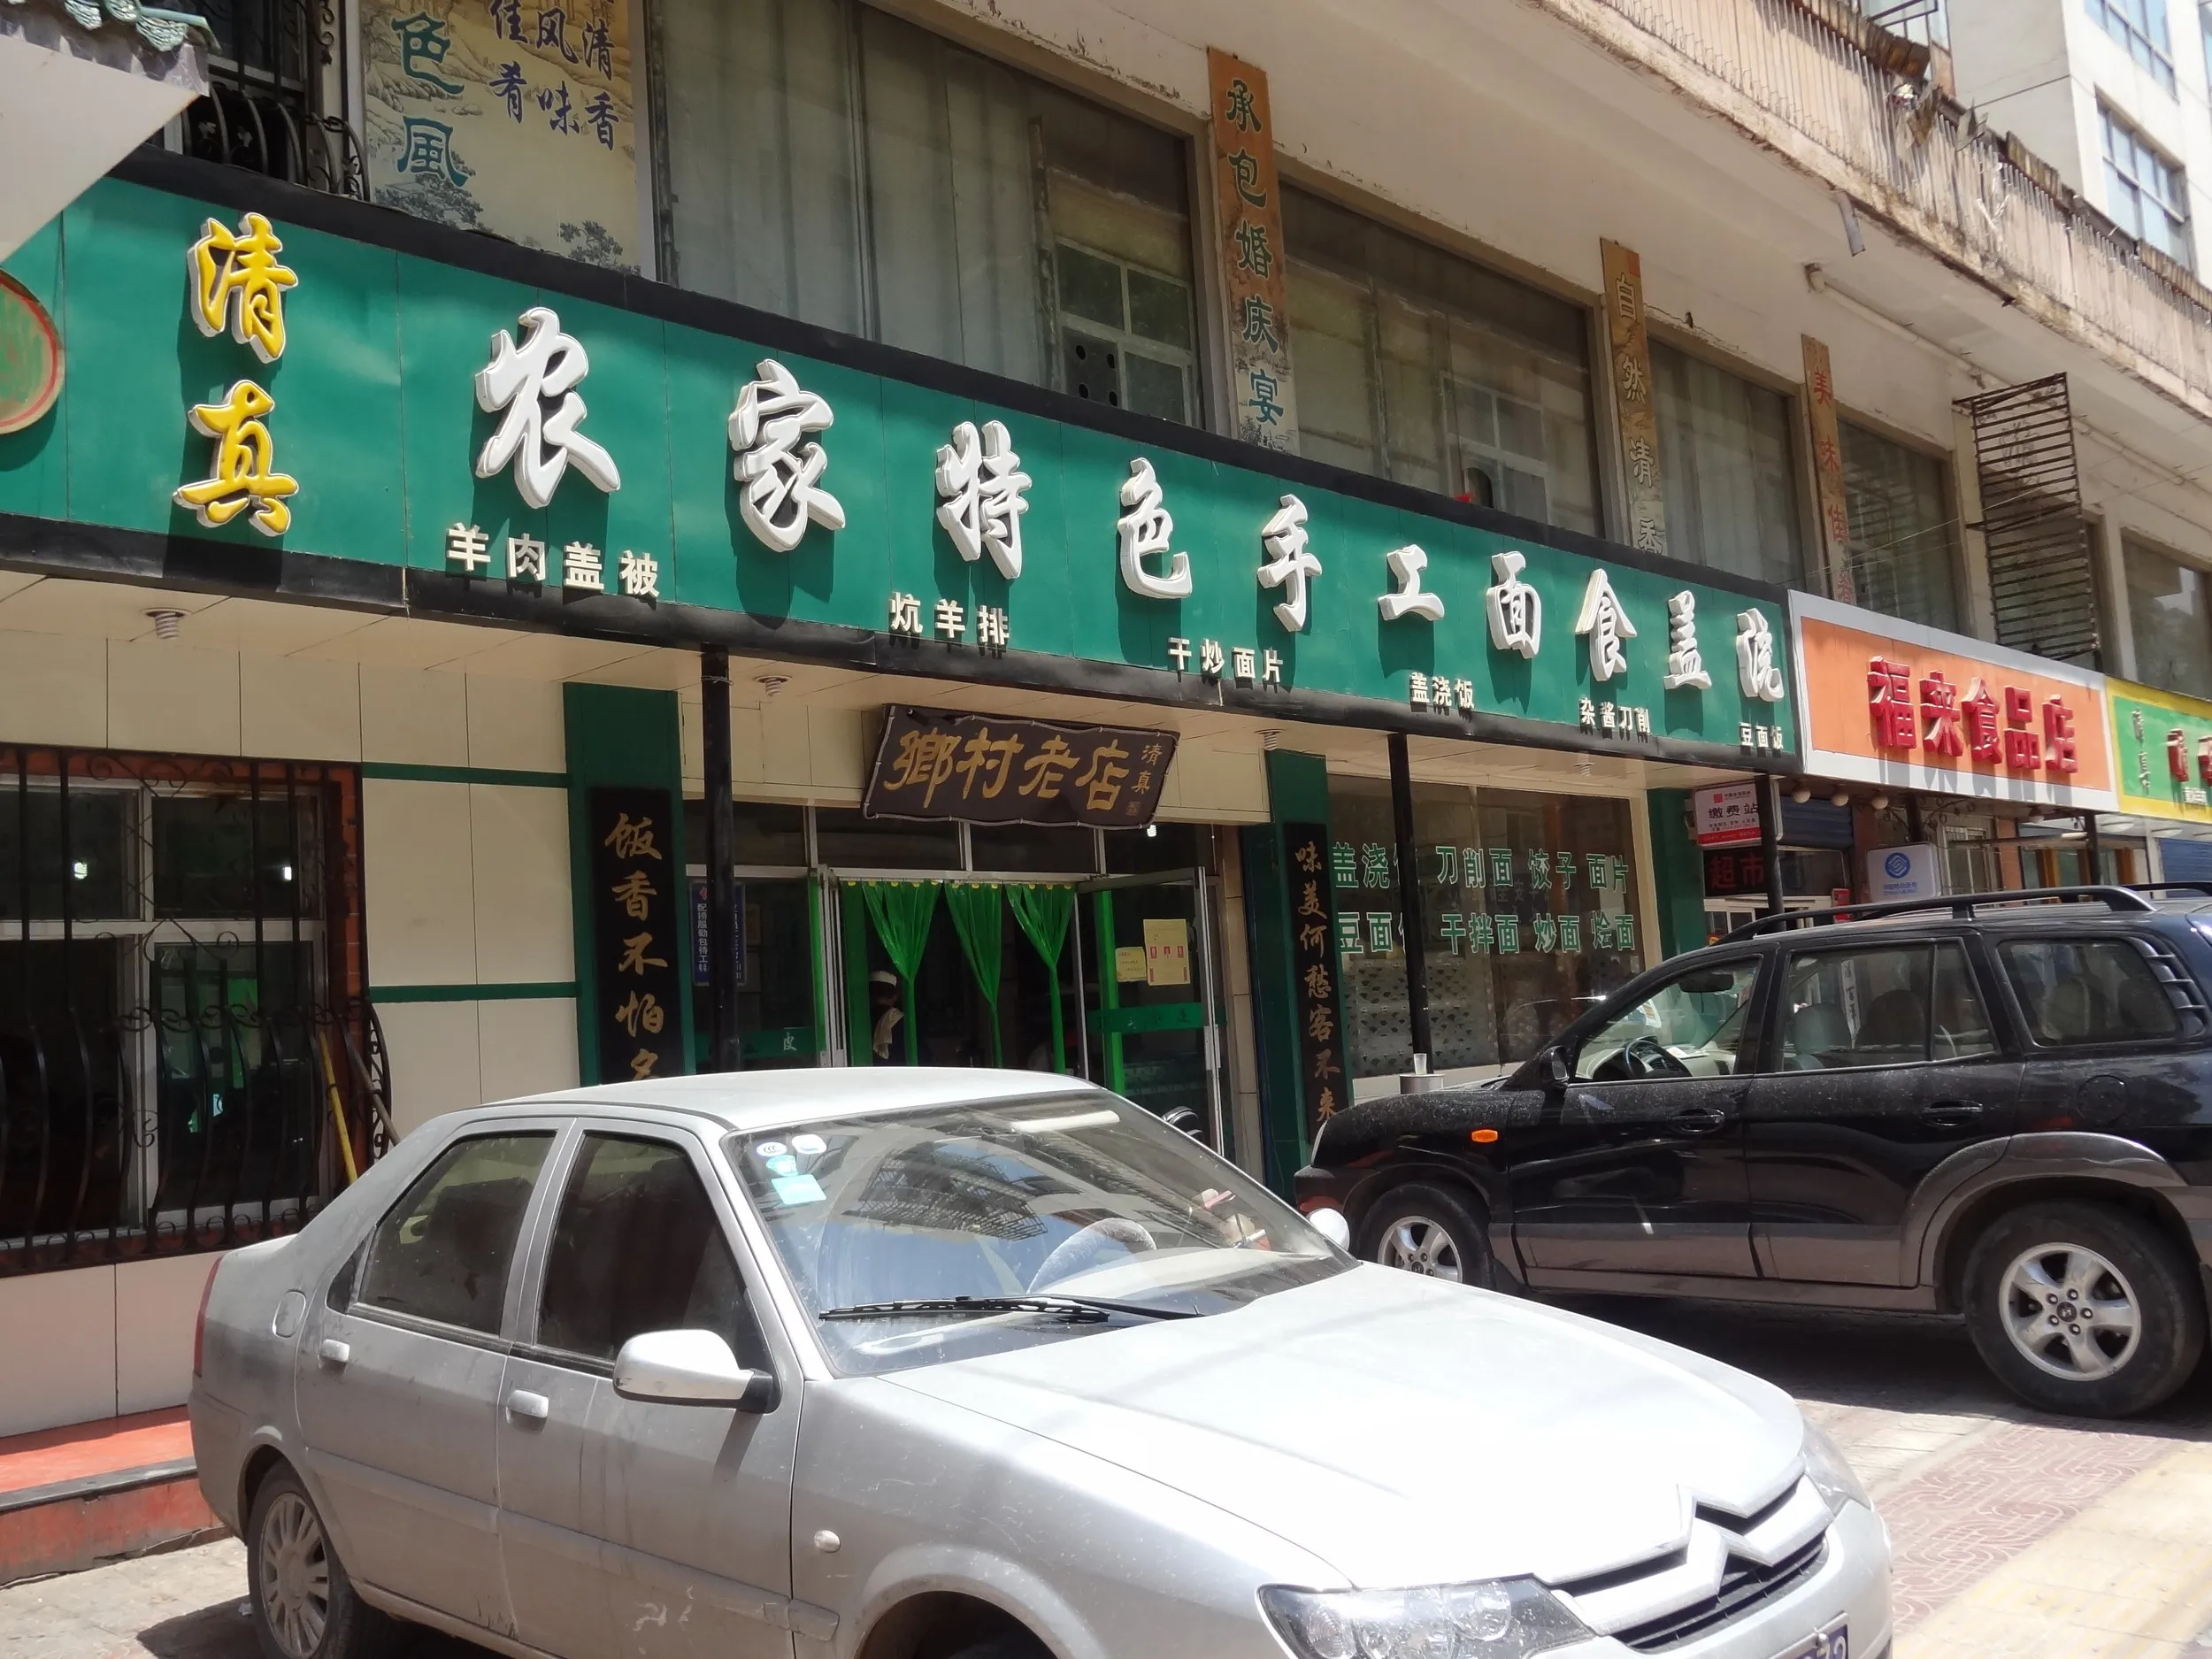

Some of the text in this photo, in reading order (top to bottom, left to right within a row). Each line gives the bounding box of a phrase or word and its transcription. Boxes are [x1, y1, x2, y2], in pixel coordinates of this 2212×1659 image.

[581, 18, 619, 151] 清香
[1225, 80, 1285, 426] 承包婚庆宴
[173, 211, 300, 536] 清真
[445, 522, 661, 598] 羊肉盖被
[889, 591, 1010, 646] 炕羊排
[1168, 636, 1284, 684] 干炒面片
[1409, 672, 1476, 709] 盖浇饭
[1578, 697, 1651, 734] 杂酱刀削
[1867, 655, 2078, 774] 福来食品店
[1131, 742, 1164, 795] 清真
[1435, 846, 1514, 888] 刀削面
[1527, 848, 1577, 890] 饺子
[1586, 853, 1629, 894] 面片
[1440, 912, 1520, 955] 干拌面
[1532, 912, 1581, 954] 炒面
